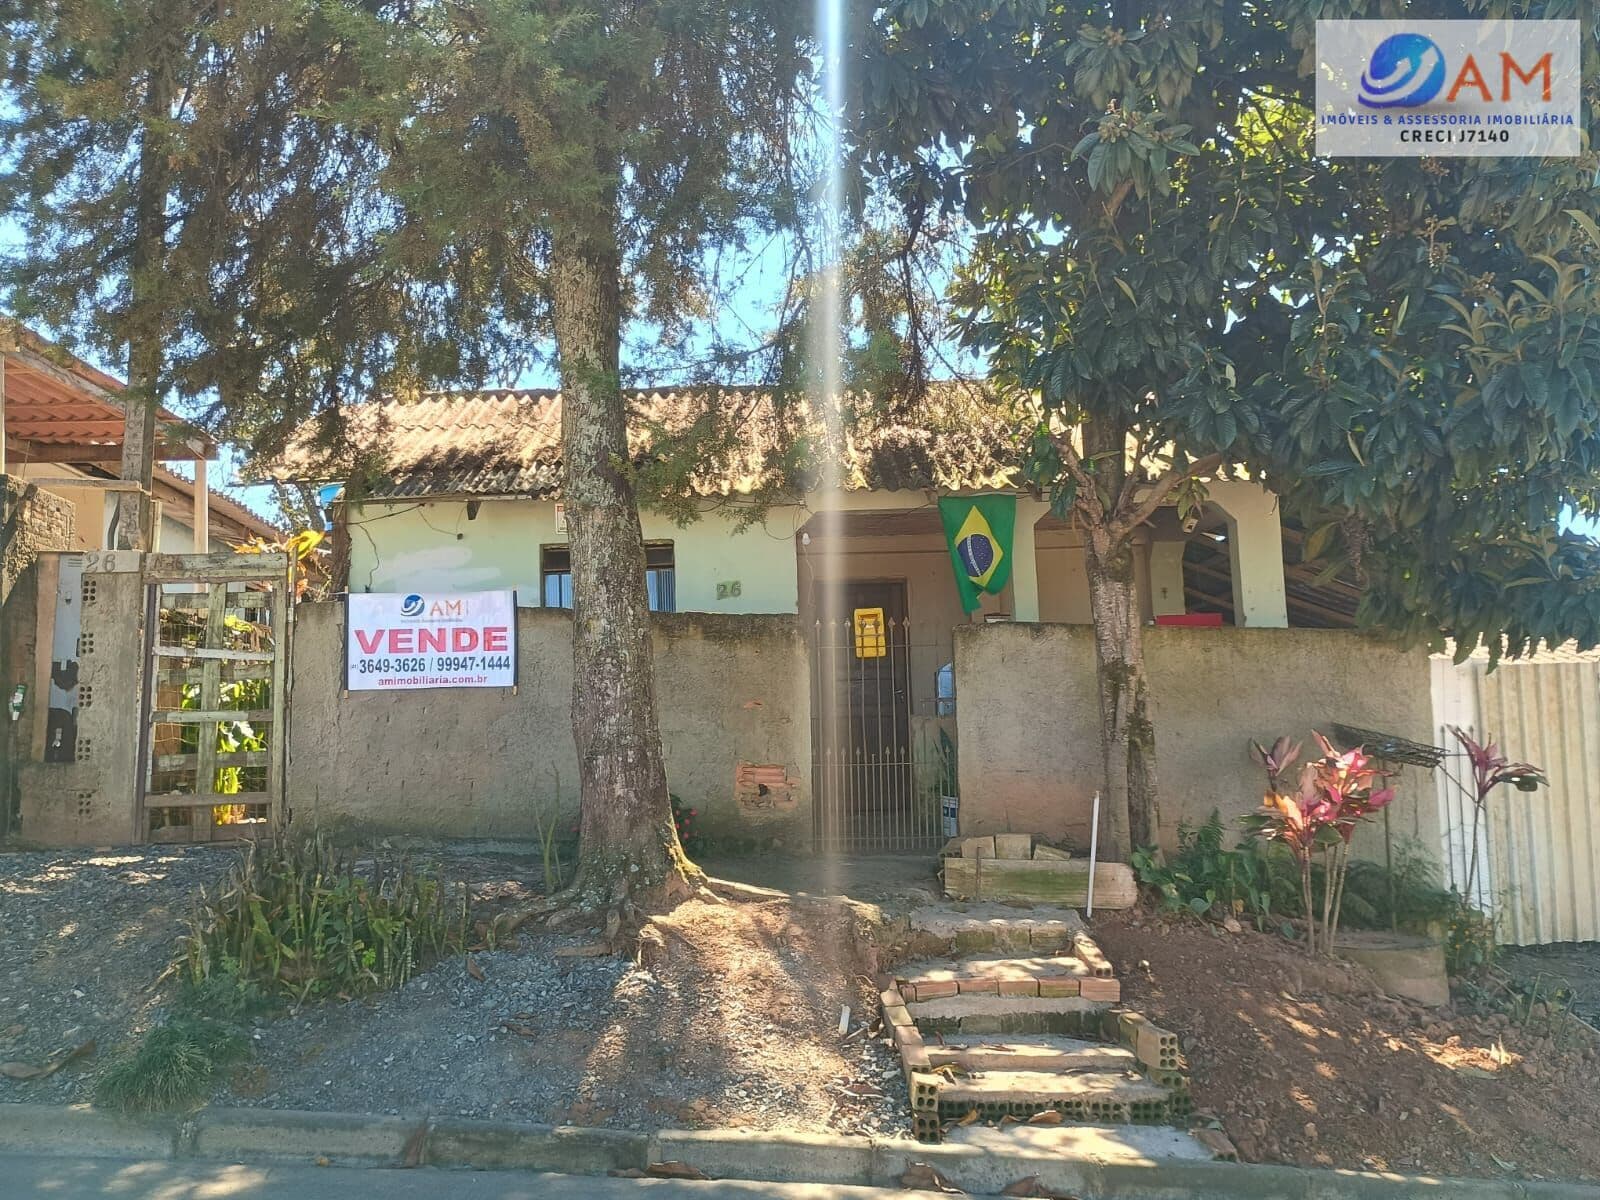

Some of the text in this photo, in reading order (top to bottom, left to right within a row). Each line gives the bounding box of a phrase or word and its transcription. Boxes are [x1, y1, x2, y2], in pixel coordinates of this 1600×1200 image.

[86, 553, 116, 572] 26
[716, 580, 742, 600] 26
[354, 627, 508, 654] VENDE
[359, 657, 426, 673] 3649-3626
[437, 655, 511, 672] 99947-1444
[378, 674, 488, 686] amimobiliaria.com.br
